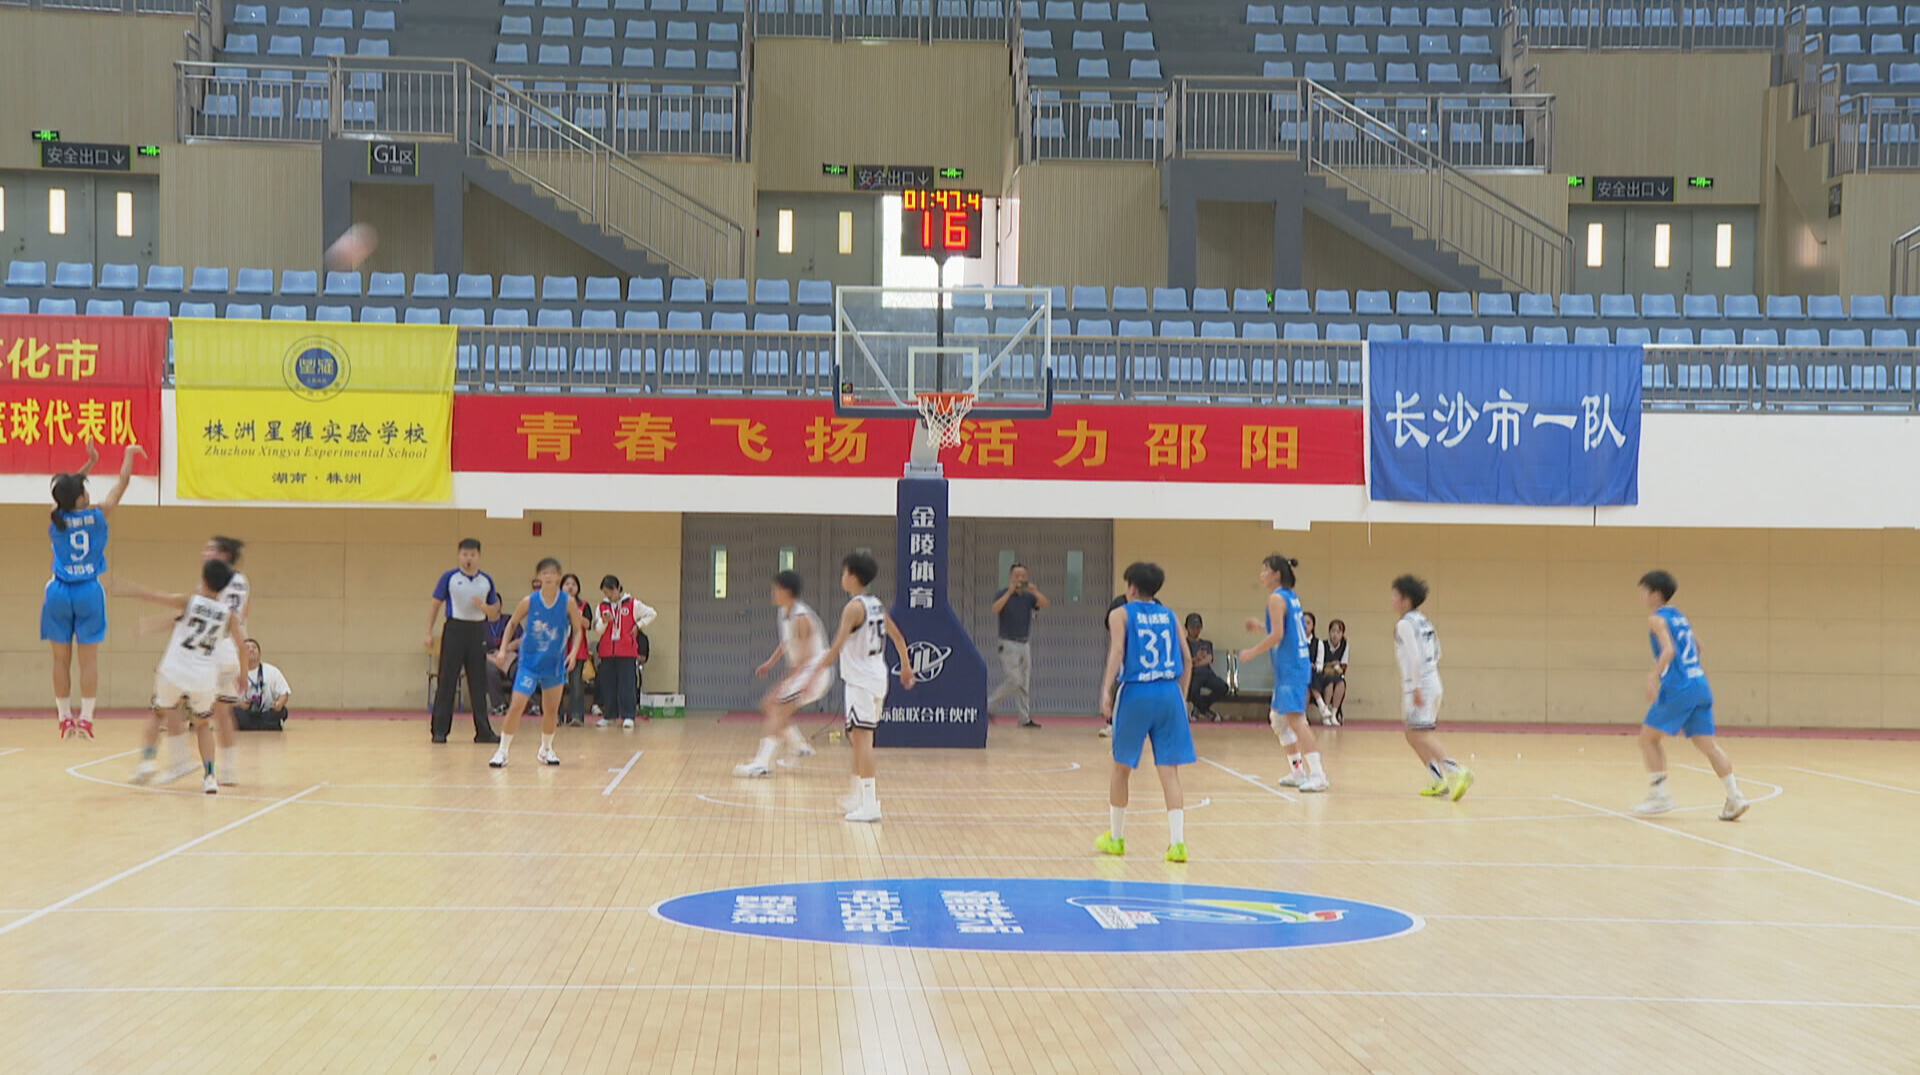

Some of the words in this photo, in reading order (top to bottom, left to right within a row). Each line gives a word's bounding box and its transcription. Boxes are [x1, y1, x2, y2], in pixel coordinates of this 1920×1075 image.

[47, 146, 110, 165] 安全出口
[373, 144, 413, 165] G1区
[858, 170, 915, 187] 安全出口
[1598, 181, 1654, 198] 安全出口
[903, 188, 981, 212] 01:47.4
[921, 210, 969, 250] 16
[0, 337, 99, 381] 化市
[202, 418, 429, 446] 株洲星雅实验学校
[1386, 388, 1626, 452] 长沙市一队
[204, 445, 256, 457] Zhuzhou
[259, 445, 301, 460] Xingya
[386, 447, 428, 460] School
[515, 411, 868, 465] 青春飞扬
[957, 419, 1299, 470] 活力邵阳
[69, 530, 90, 562] 9
[909, 506, 936, 609] 金陵体育
[182, 617, 221, 656] 24
[1137, 628, 1176, 669] 31
